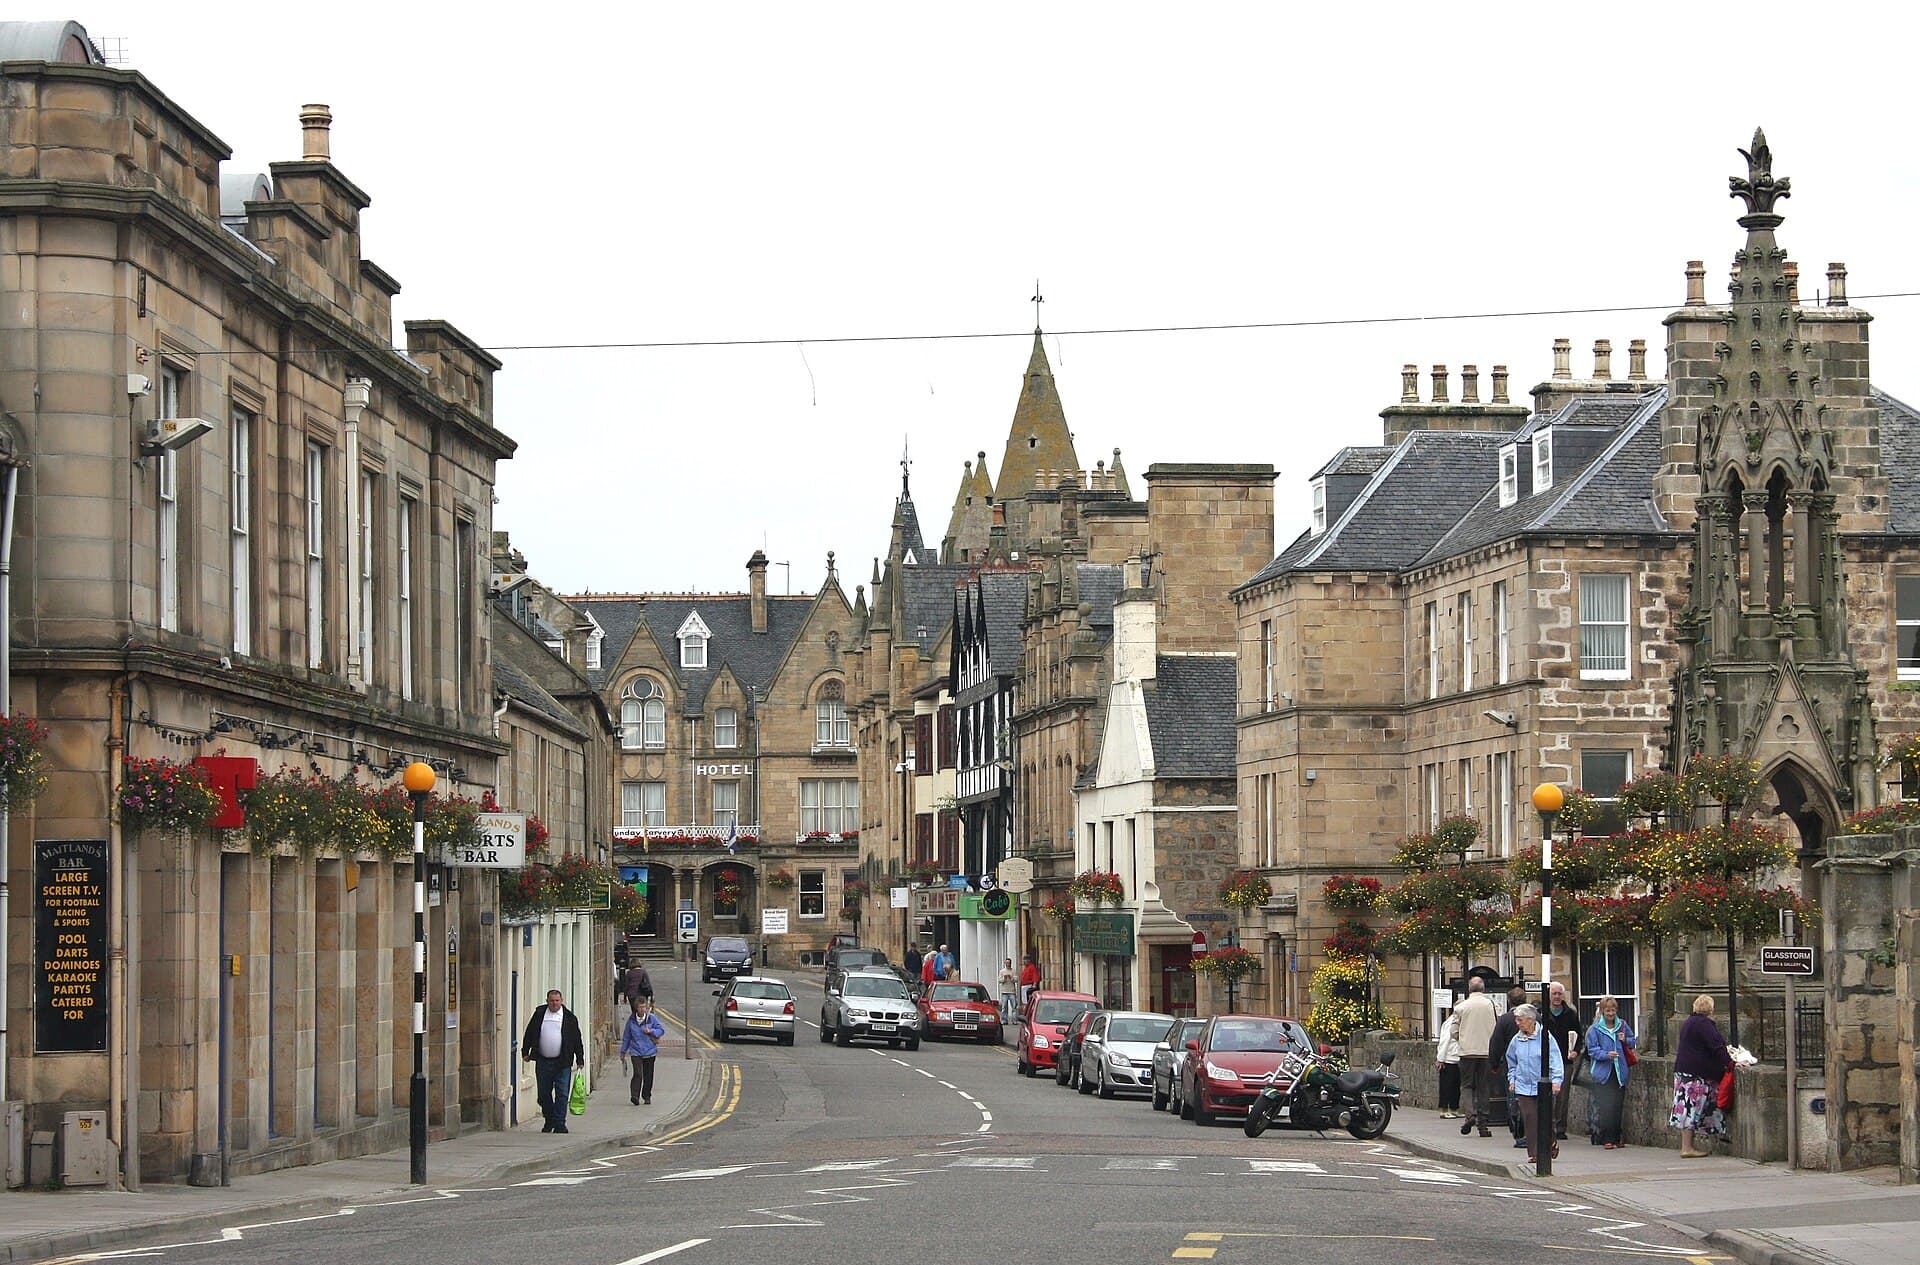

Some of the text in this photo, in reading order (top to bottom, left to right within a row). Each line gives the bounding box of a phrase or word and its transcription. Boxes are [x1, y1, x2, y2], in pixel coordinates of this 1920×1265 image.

[696, 764, 753, 776] HOTEL
[614, 829, 641, 837] unday
[470, 834, 515, 848] ORTS
[464, 850, 499, 863] BAR
[59, 858, 85, 868] BAR
[55, 872, 89, 882] LARGE
[42, 885, 101, 896] SCREEN T.V.
[45, 898, 100, 907] FOR FOOTBALL
[56, 909, 87, 917] RACING
[53, 918, 90, 927] & SPORTS
[682, 914, 694, 928] P
[58, 934, 87, 944] POOL
[56, 948, 88, 958] DARTS
[1764, 951, 1811, 960] GLASSTORM
[44, 960, 100, 970] DOMINOES
[47, 973, 97, 982] KARAOKE
[53, 984, 91, 994] PARTYS
[51, 997, 94, 1007] CATERED
[63, 1010, 84, 1020] FOR
